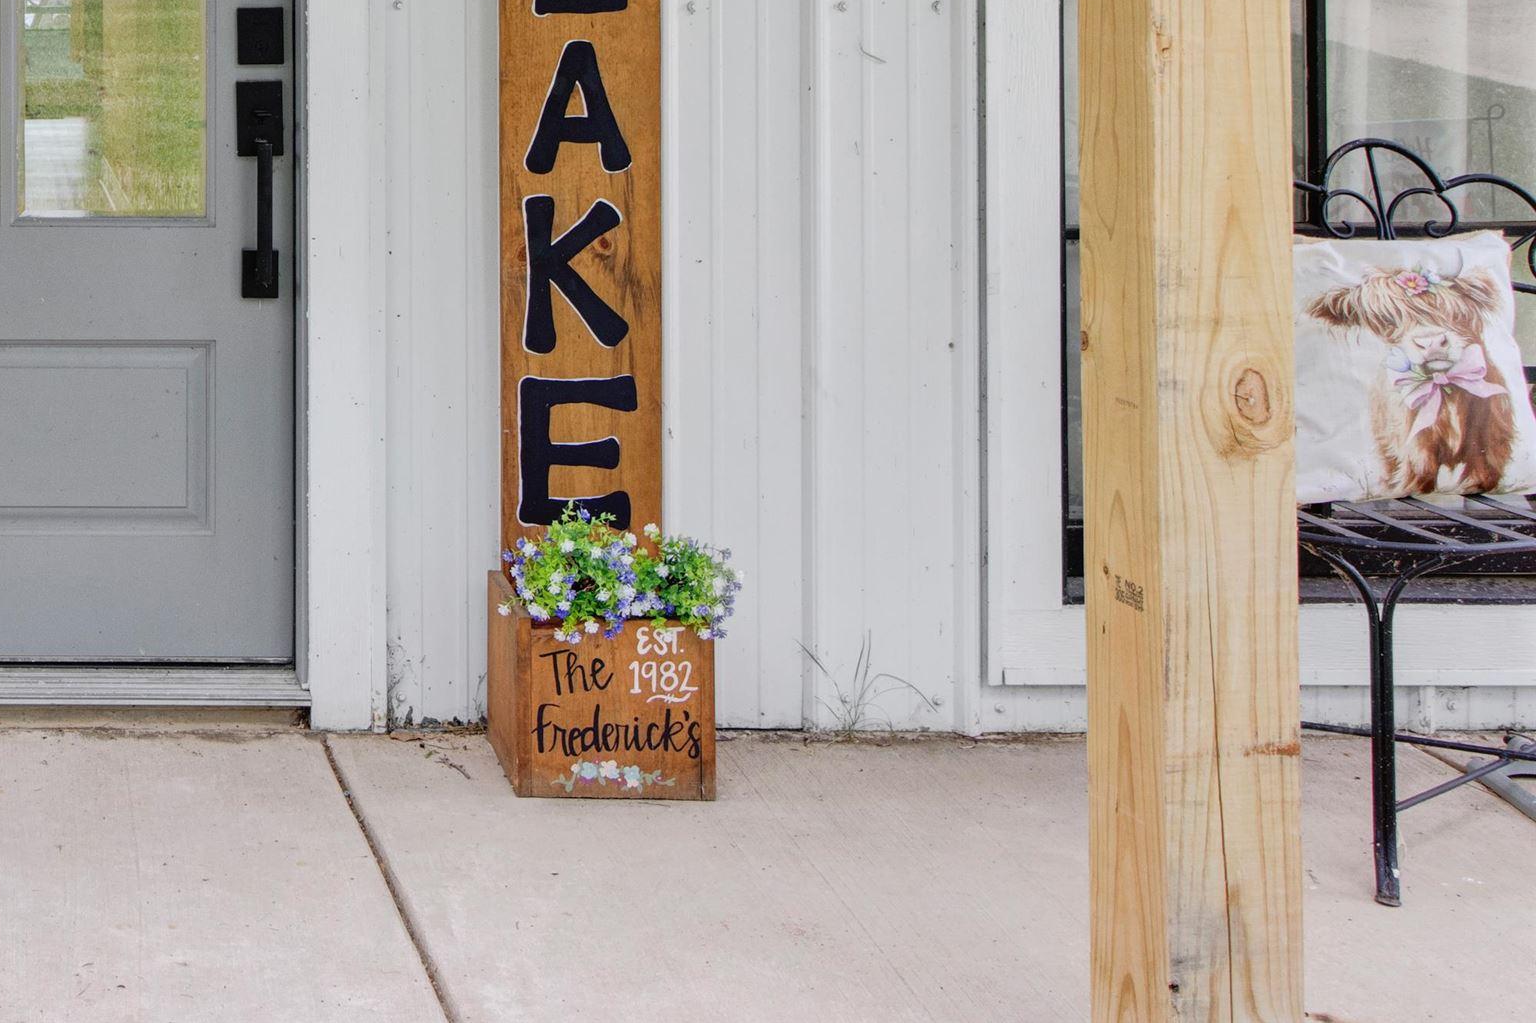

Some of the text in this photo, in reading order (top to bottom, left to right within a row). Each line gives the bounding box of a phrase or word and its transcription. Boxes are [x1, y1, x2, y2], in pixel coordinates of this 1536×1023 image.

[636, 626, 685, 655] EST.
[539, 649, 614, 696] The
[629, 660, 699, 694] 1982
[531, 703, 701, 759] Frederick's
